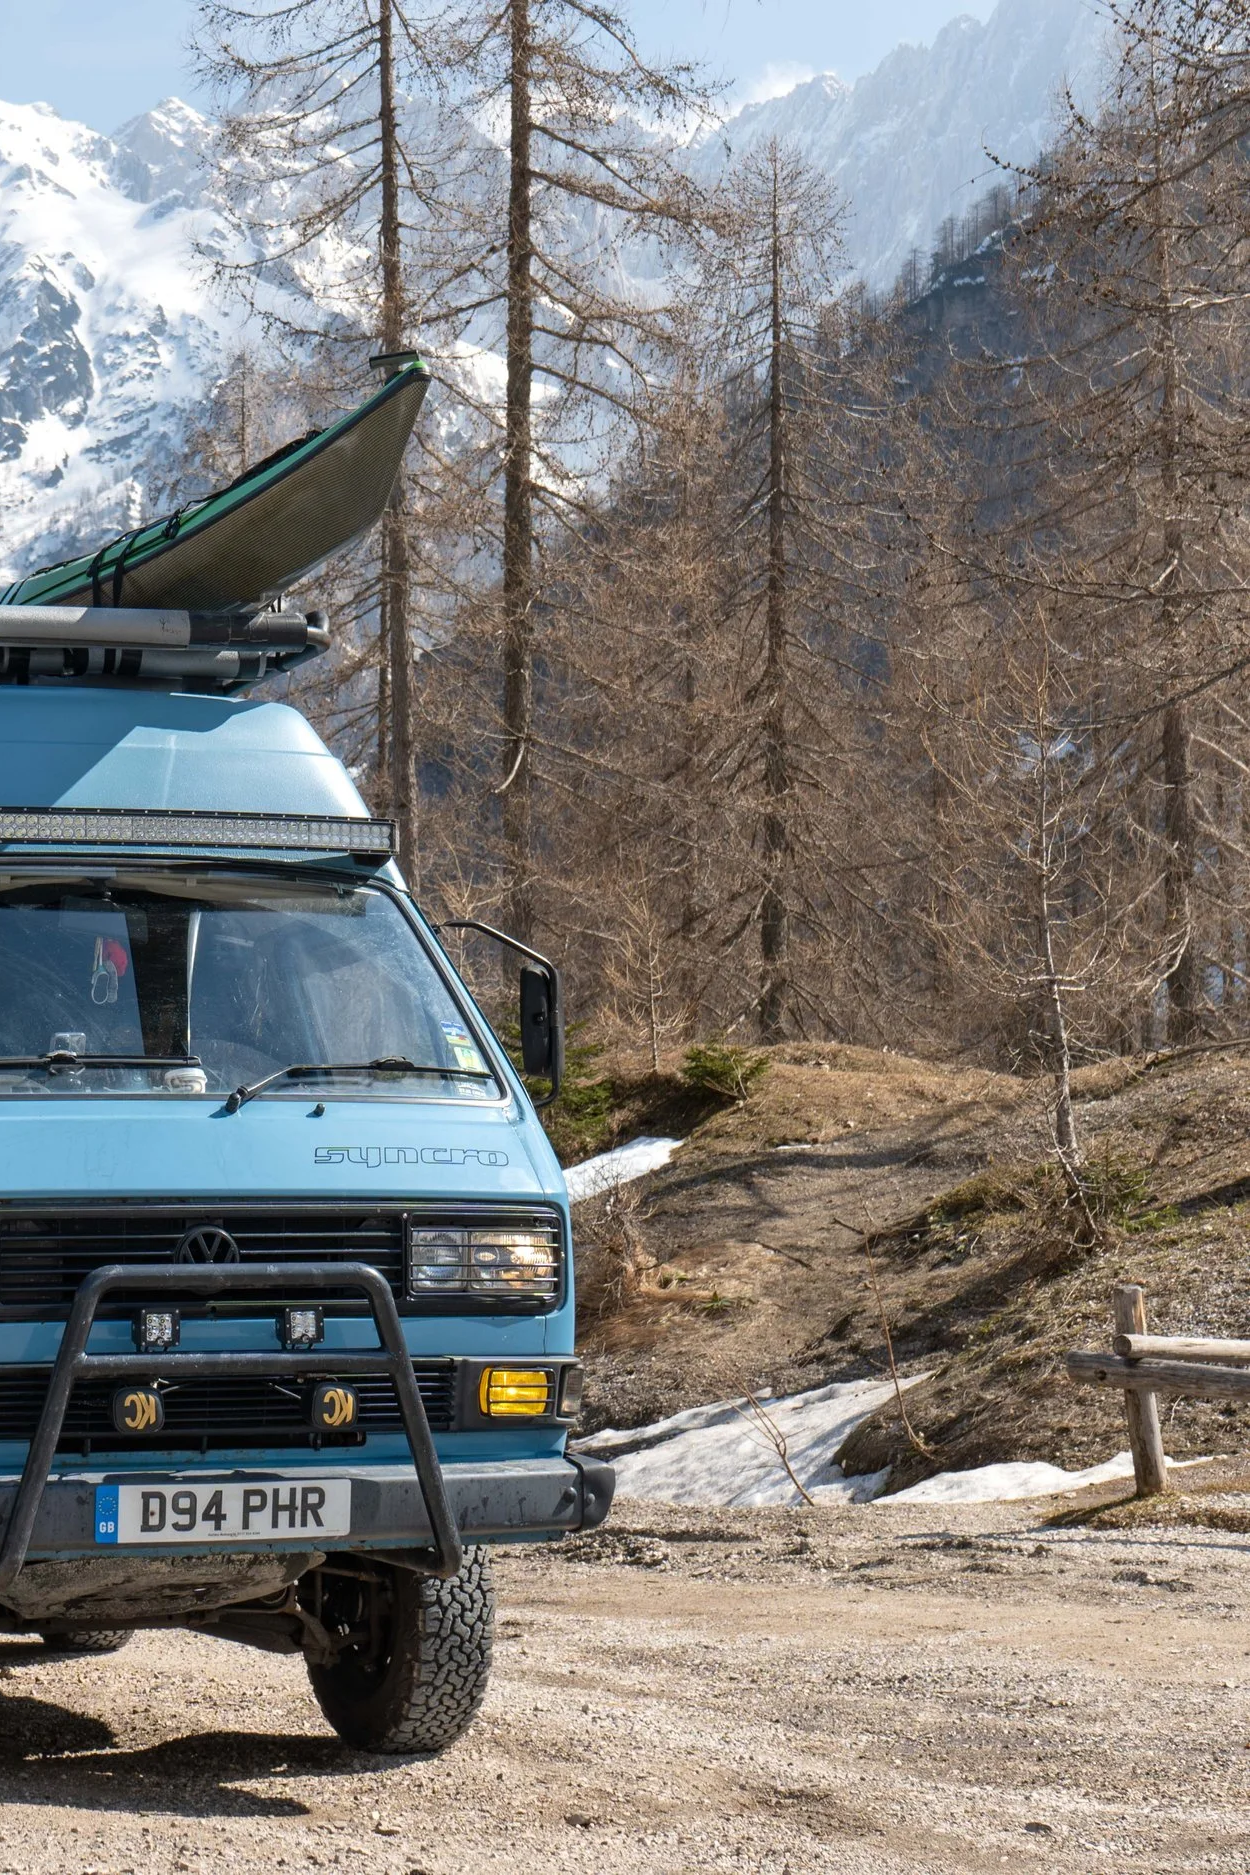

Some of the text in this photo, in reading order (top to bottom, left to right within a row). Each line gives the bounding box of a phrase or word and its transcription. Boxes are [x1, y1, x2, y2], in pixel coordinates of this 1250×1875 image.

[314, 1146, 509, 1168] syncro
[124, 1391, 156, 1430] KC
[323, 1388, 353, 1426] KC
[99, 1521, 115, 1534] GB
[140, 1486, 326, 1533] D94 PHR
